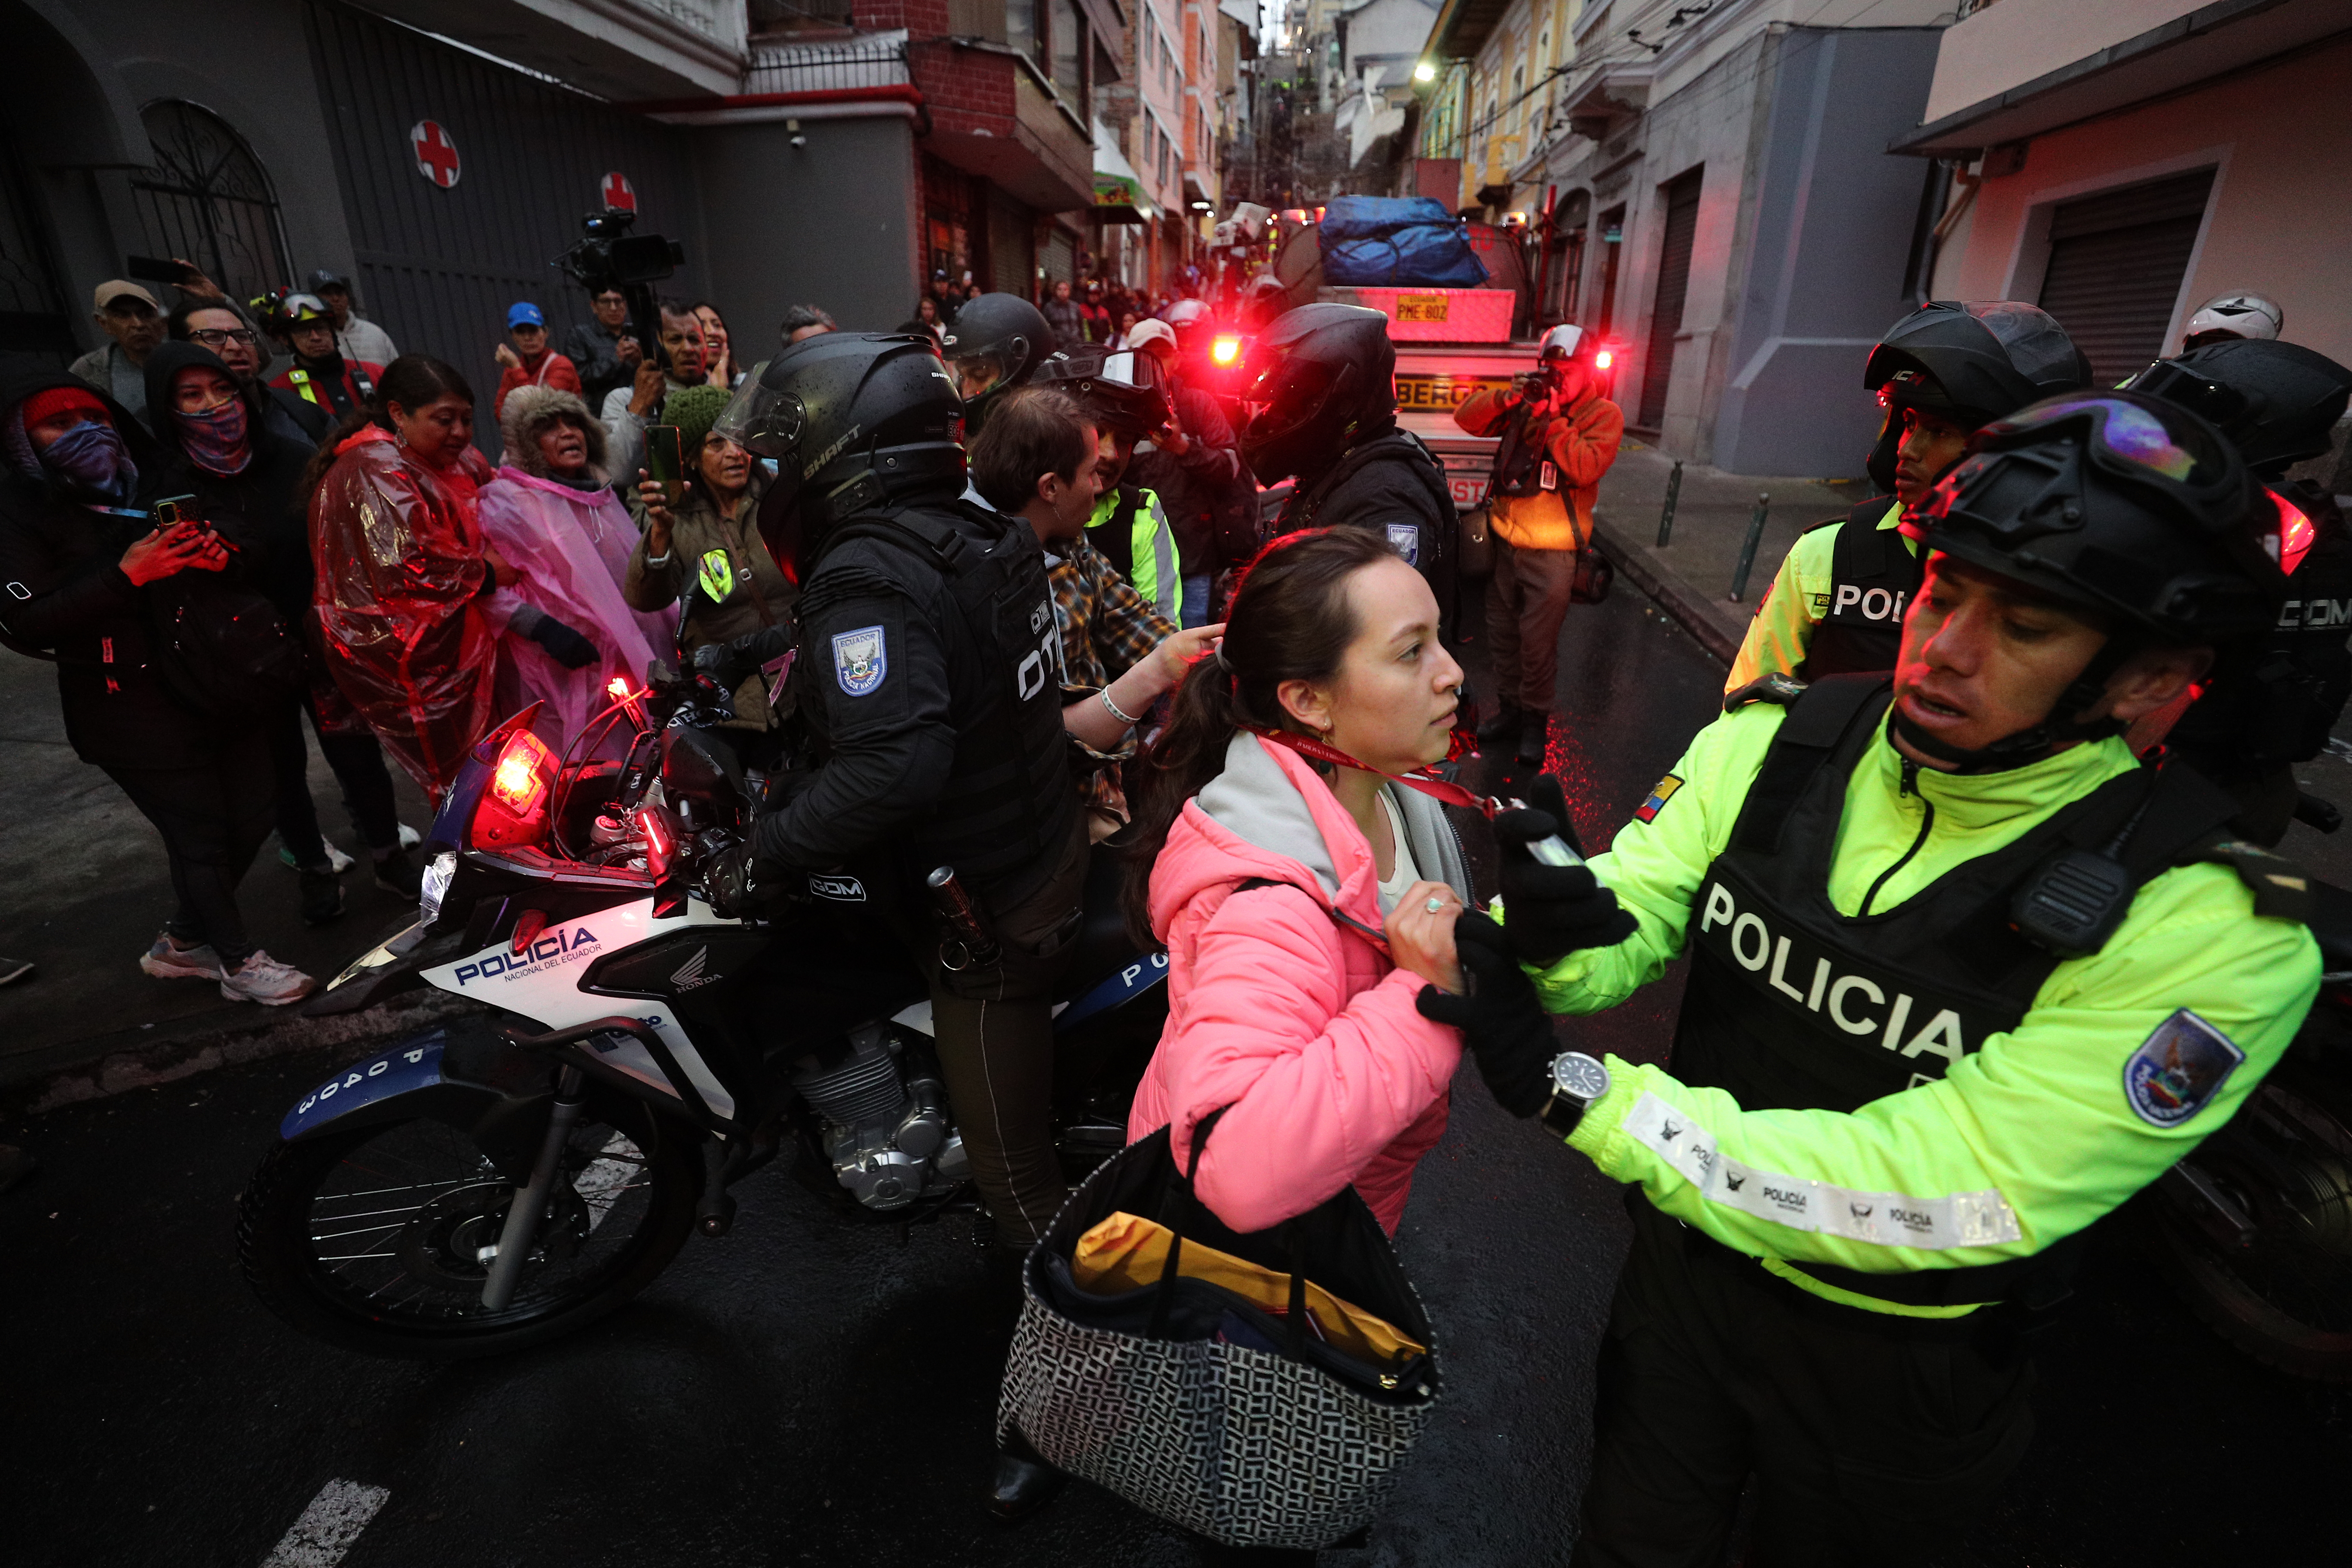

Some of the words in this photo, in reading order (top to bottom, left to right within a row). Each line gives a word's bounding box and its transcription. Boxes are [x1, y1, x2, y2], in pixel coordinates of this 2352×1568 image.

[804, 423, 861, 480] SHAFT
[840, 633, 876, 647] ECUADOR
[860, 663, 879, 690] NACIONAL
[454, 928, 598, 986] POLICÍA
[504, 965, 544, 983] NACIONAL
[544, 959, 560, 970] DEL
[561, 943, 602, 964] ECUADOR
[1701, 882, 1965, 1066] POLICIA
[675, 974, 723, 994] HONDA
